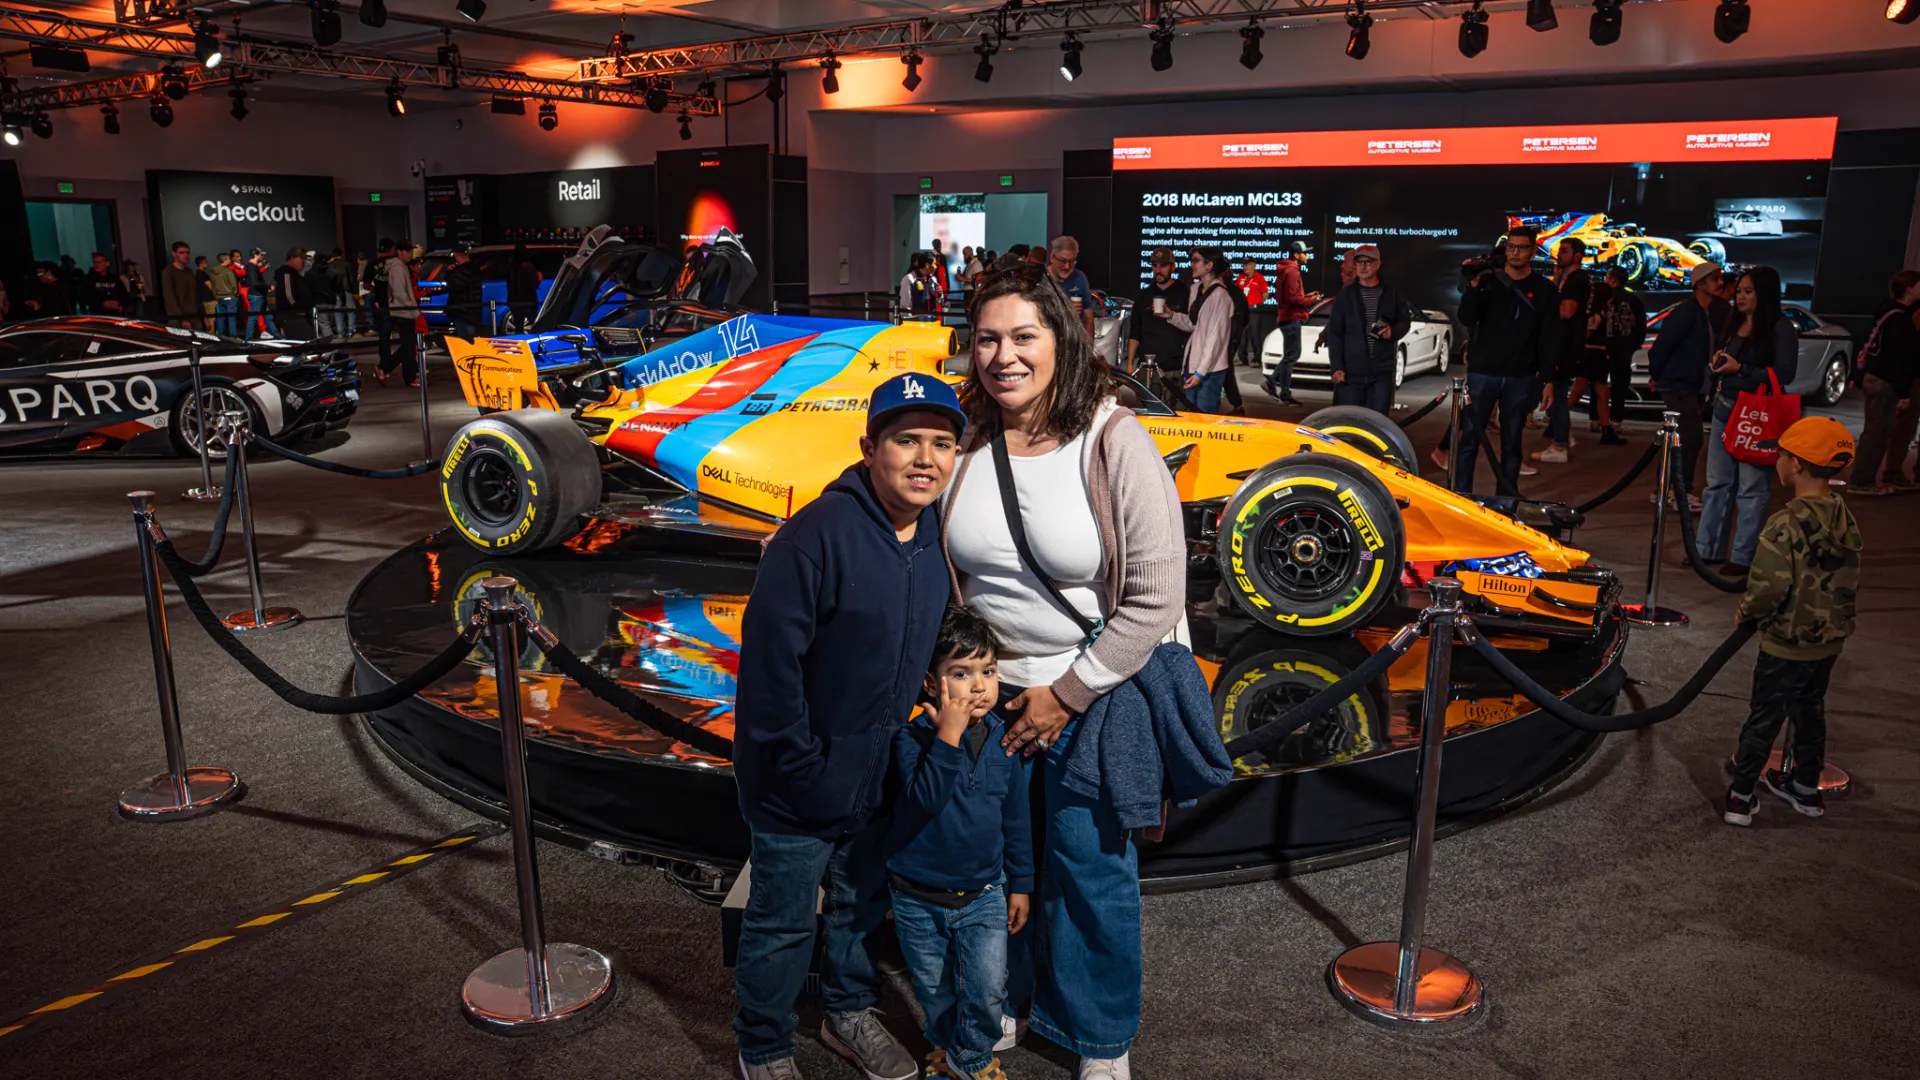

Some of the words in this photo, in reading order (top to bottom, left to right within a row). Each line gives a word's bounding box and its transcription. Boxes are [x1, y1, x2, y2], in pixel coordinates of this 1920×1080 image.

[1367, 140, 1442, 149] PETERSEN
[1523, 136, 1597, 147] PETERSEN
[1686, 132, 1772, 143] PETERSEN
[1113, 147, 1152, 155] ERSEN
[1222, 143, 1289, 153] PETERSEN
[241, 184, 273, 195] SPARQ
[557, 178, 601, 202] Retail
[1142, 193, 1179, 207] 2018
[1181, 193, 1244, 207] McLaren
[1247, 192, 1302, 206] MCL33
[199, 200, 306, 222] Checkout
[1223, 216, 1255, 225] powered
[1256, 216, 1266, 225] by
[1273, 216, 1302, 224] Renault
[1336, 215, 1361, 224] Engine
[1141, 227, 1165, 236] engine
[1166, 226, 1183, 234] after
[1184, 227, 1218, 236] switching
[1219, 227, 1236, 235] from
[1399, 228, 1447, 237] turbocharged
[1448, 228, 1459, 236] V6
[1141, 238, 1172, 246] mounted
[1173, 238, 1193, 246] turbo
[1194, 238, 1221, 247] charger
[1237, 239, 1280, 247] mechanical
[717, 313, 760, 359] 14
[482, 364, 523, 375] Communications
[902, 375, 926, 400] LA
[778, 398, 870, 412] PETROBRA
[619, 421, 694, 435] RENAULT
[1149, 426, 1203, 439] RICHARD
[1207, 431, 1245, 442] MILLE
[1737, 421, 1763, 435] Go
[442, 433, 470, 479] PIRELLI
[527, 478, 538, 496] P
[702, 464, 732, 486] DELL
[734, 471, 791, 499] Technologies
[496, 502, 537, 548] ZERO
[1337, 487, 1385, 553] PIRELLI
[1231, 530, 1272, 610] ZERO
[1482, 577, 1527, 594] Hilton
[1275, 613, 1299, 625] P
